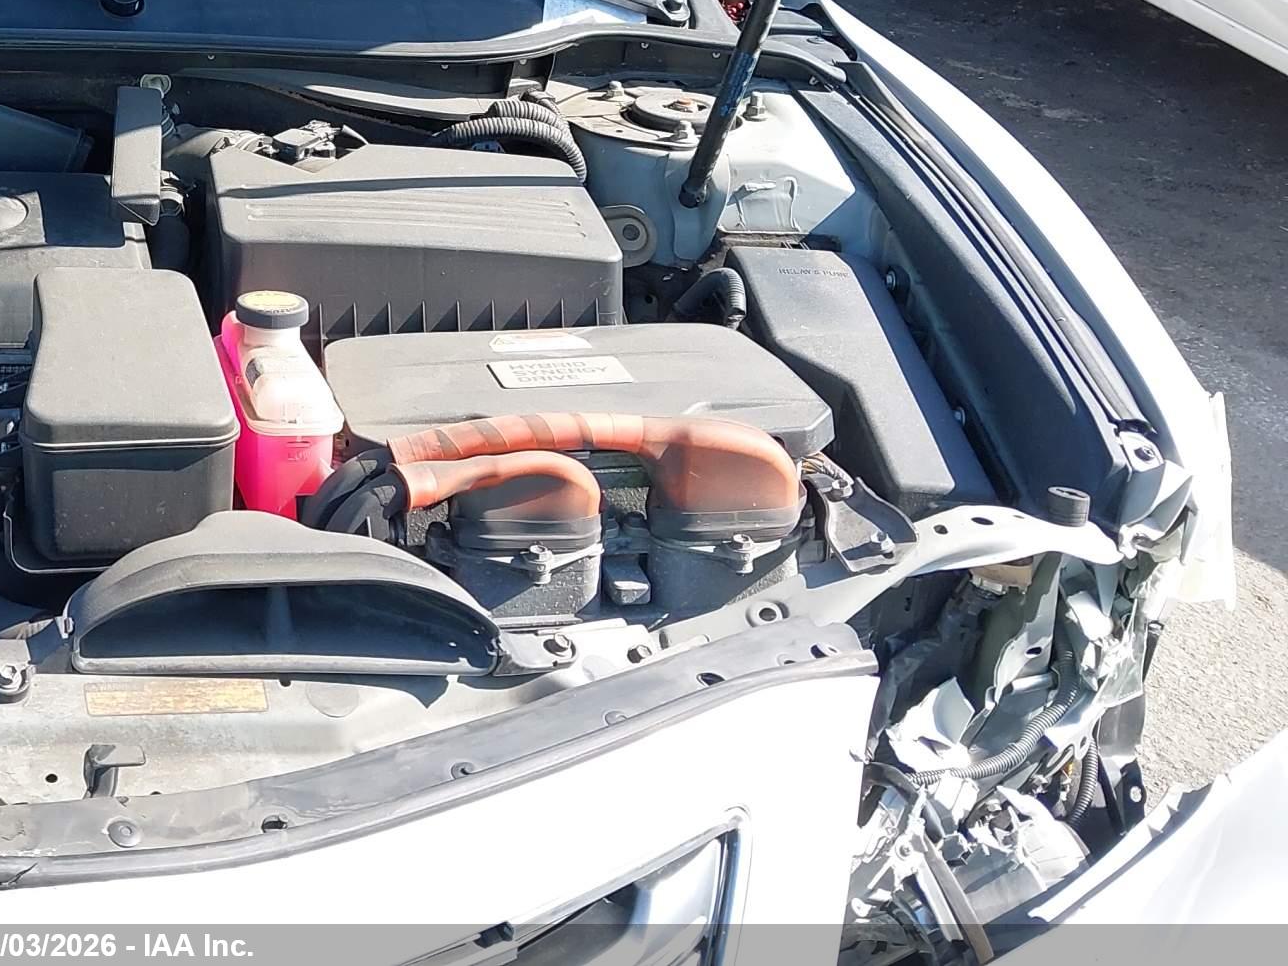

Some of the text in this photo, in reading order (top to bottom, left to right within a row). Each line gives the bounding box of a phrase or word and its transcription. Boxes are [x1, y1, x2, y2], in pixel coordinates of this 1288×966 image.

[509, 361, 587, 371] HYBRID
[512, 366, 608, 377] SYNERGY
[517, 374, 580, 383] DRIVE
